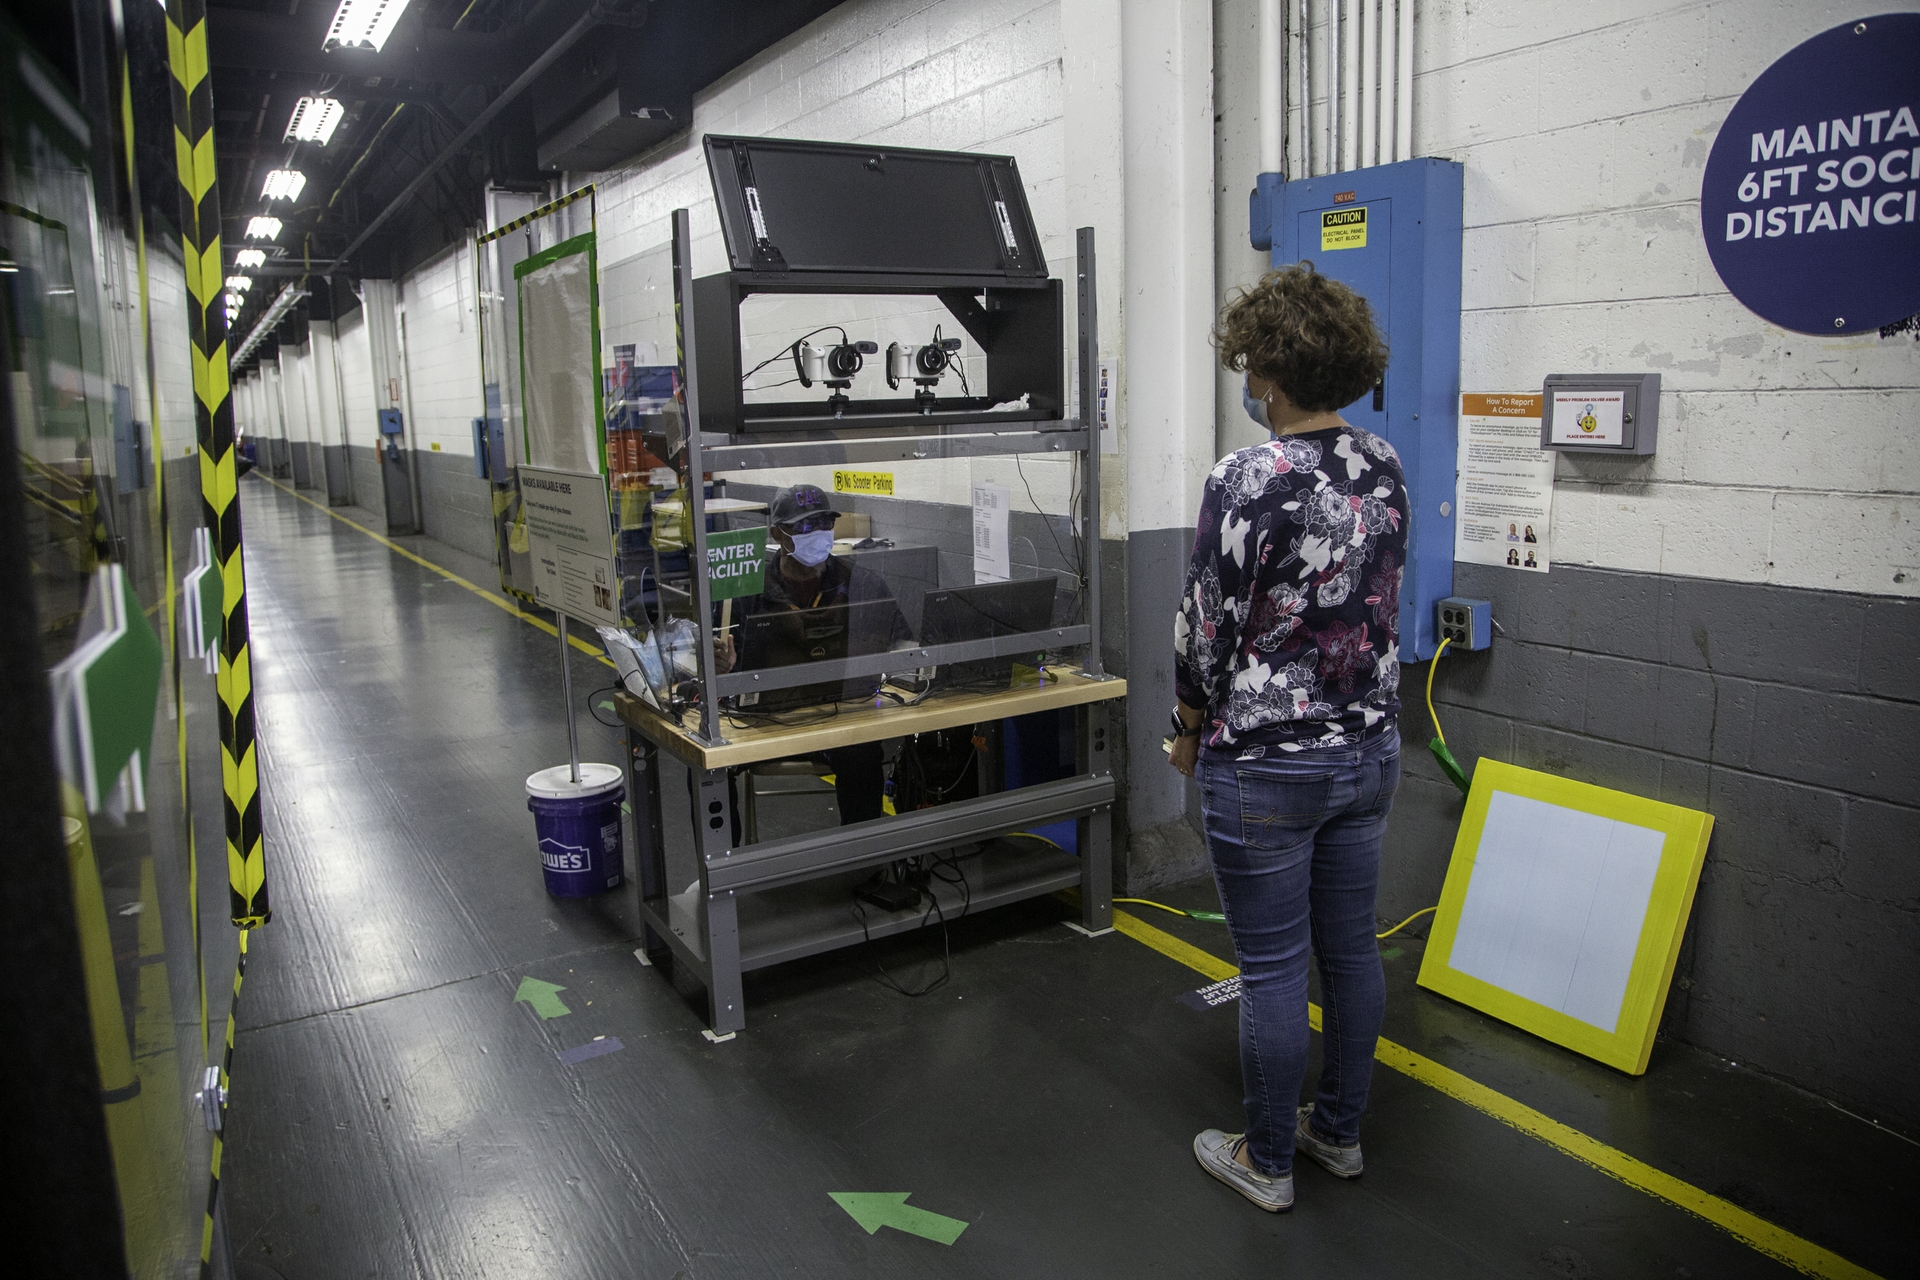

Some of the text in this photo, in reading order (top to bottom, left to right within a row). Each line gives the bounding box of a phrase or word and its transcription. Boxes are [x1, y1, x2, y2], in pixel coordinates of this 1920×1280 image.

[1751, 106, 1920, 163] MAINTA
[1737, 164, 1808, 202] 6FT
[1335, 195, 1343, 203] 240
[1326, 211, 1361, 225] CAUTION
[1726, 190, 1916, 242] DISTANCI
[1486, 397, 1500, 405] How
[1511, 398, 1534, 407] Report
[522, 476, 572, 494] MASKS AVAILABLE HERE
[844, 474, 893, 495] No Scooter Parking
[795, 489, 821, 507] CAL
[707, 543, 754, 563] ENTER
[1203, 989, 1221, 1000] 6FT
